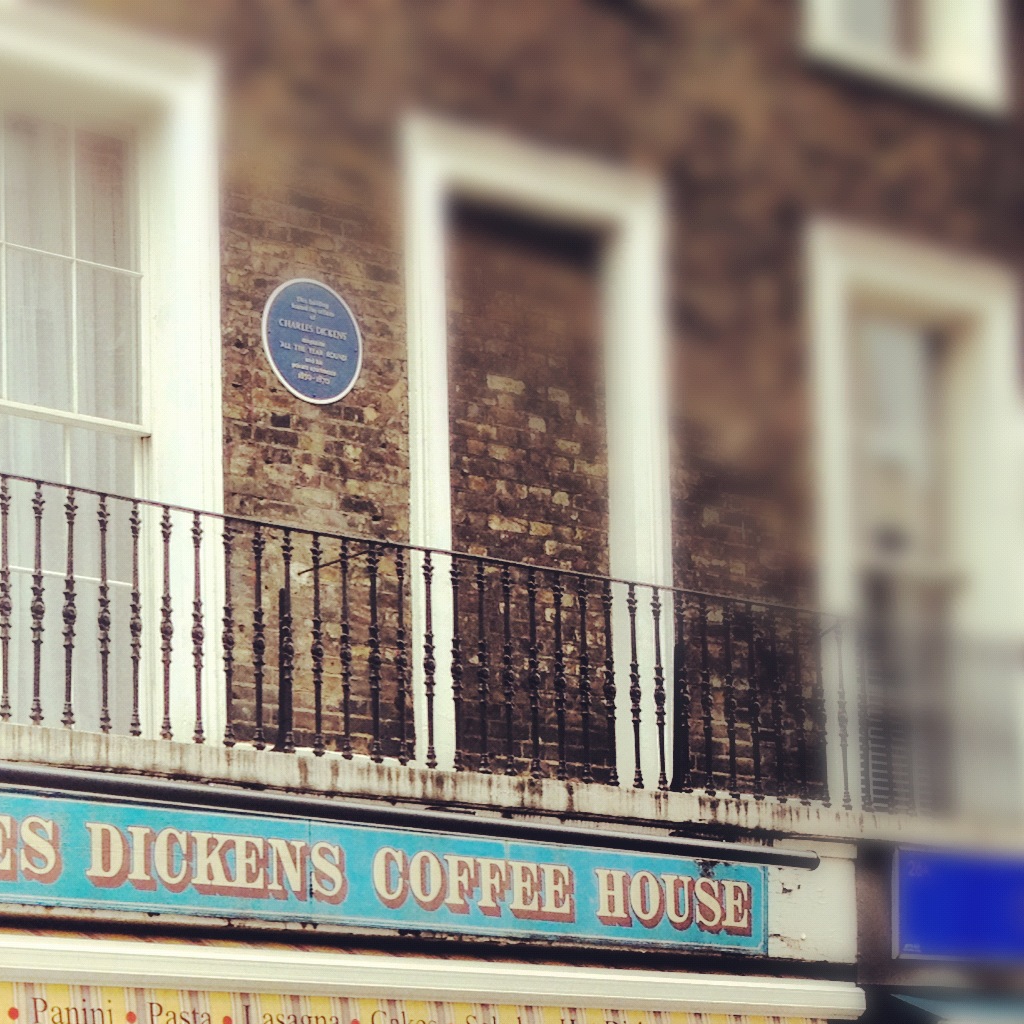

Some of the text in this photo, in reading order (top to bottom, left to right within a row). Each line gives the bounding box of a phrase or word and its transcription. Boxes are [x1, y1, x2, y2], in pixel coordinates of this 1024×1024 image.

[279, 319, 314, 332] CHARLES
[85, 820, 346, 904] DICKENS
[372, 846, 574, 923] COFFEE
[594, 866, 752, 937] HOUSE
